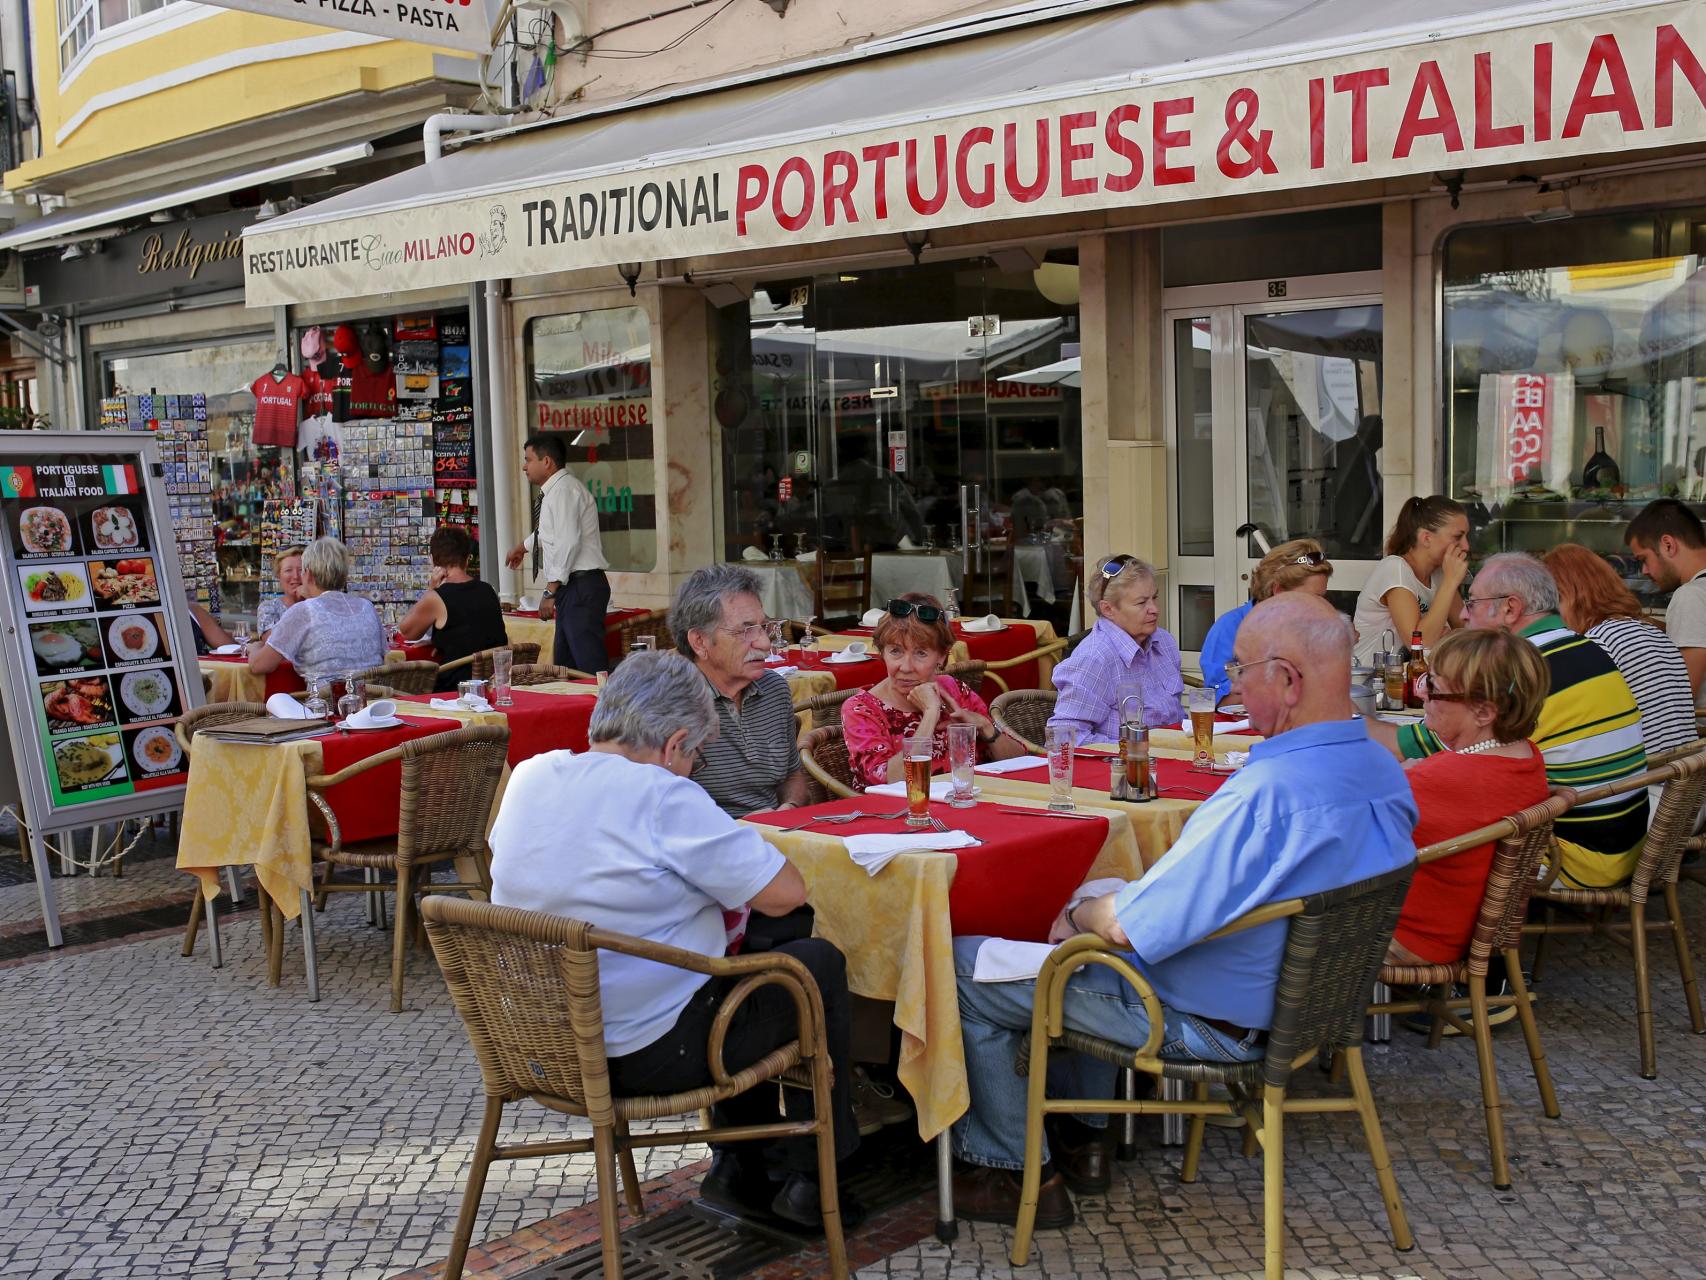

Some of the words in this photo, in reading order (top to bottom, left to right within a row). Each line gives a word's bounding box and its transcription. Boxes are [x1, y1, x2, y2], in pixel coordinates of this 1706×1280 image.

[397, 4, 459, 32] PASTA
[249, 238, 360, 275] RESTAURANTE
[360, 234, 402, 271] Ciao
[403, 232, 475, 263] MILANO
[523, 172, 729, 247] TRADITIONAL
[736, 97, 1196, 237] PORTUGUESE
[1216, 88, 1279, 179] &
[1308, 24, 1706, 170] ITALIAN
[1268, 282, 1286, 296] 35
[538, 402, 648, 436] Portuguese
[36, 465, 99, 475] PORTUGUESE
[40, 487, 77, 497] ITALIAN
[79, 486, 104, 496] FOOD
[59, 666, 85, 674] BITOQUE
[1061, 742, 1070, 771] SAGRES
